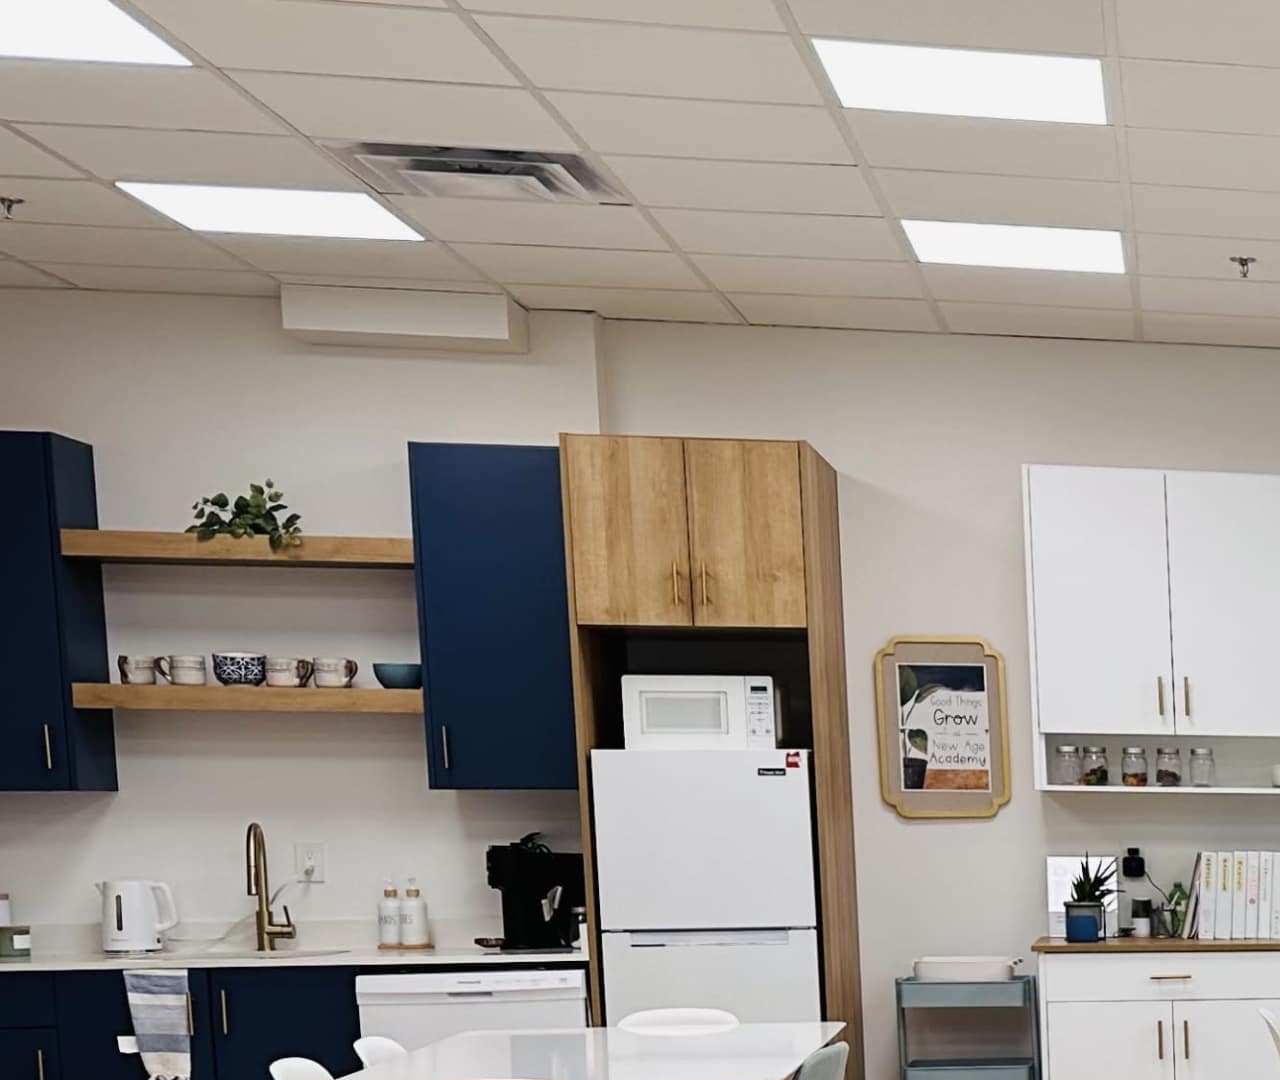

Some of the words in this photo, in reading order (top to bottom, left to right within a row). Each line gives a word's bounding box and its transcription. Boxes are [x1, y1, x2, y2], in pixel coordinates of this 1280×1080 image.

[931, 696, 952, 707] Good
[933, 708, 978, 726] Grow
[932, 740, 959, 752] New
[965, 741, 985, 755] Age
[930, 753, 986, 767] Academy
